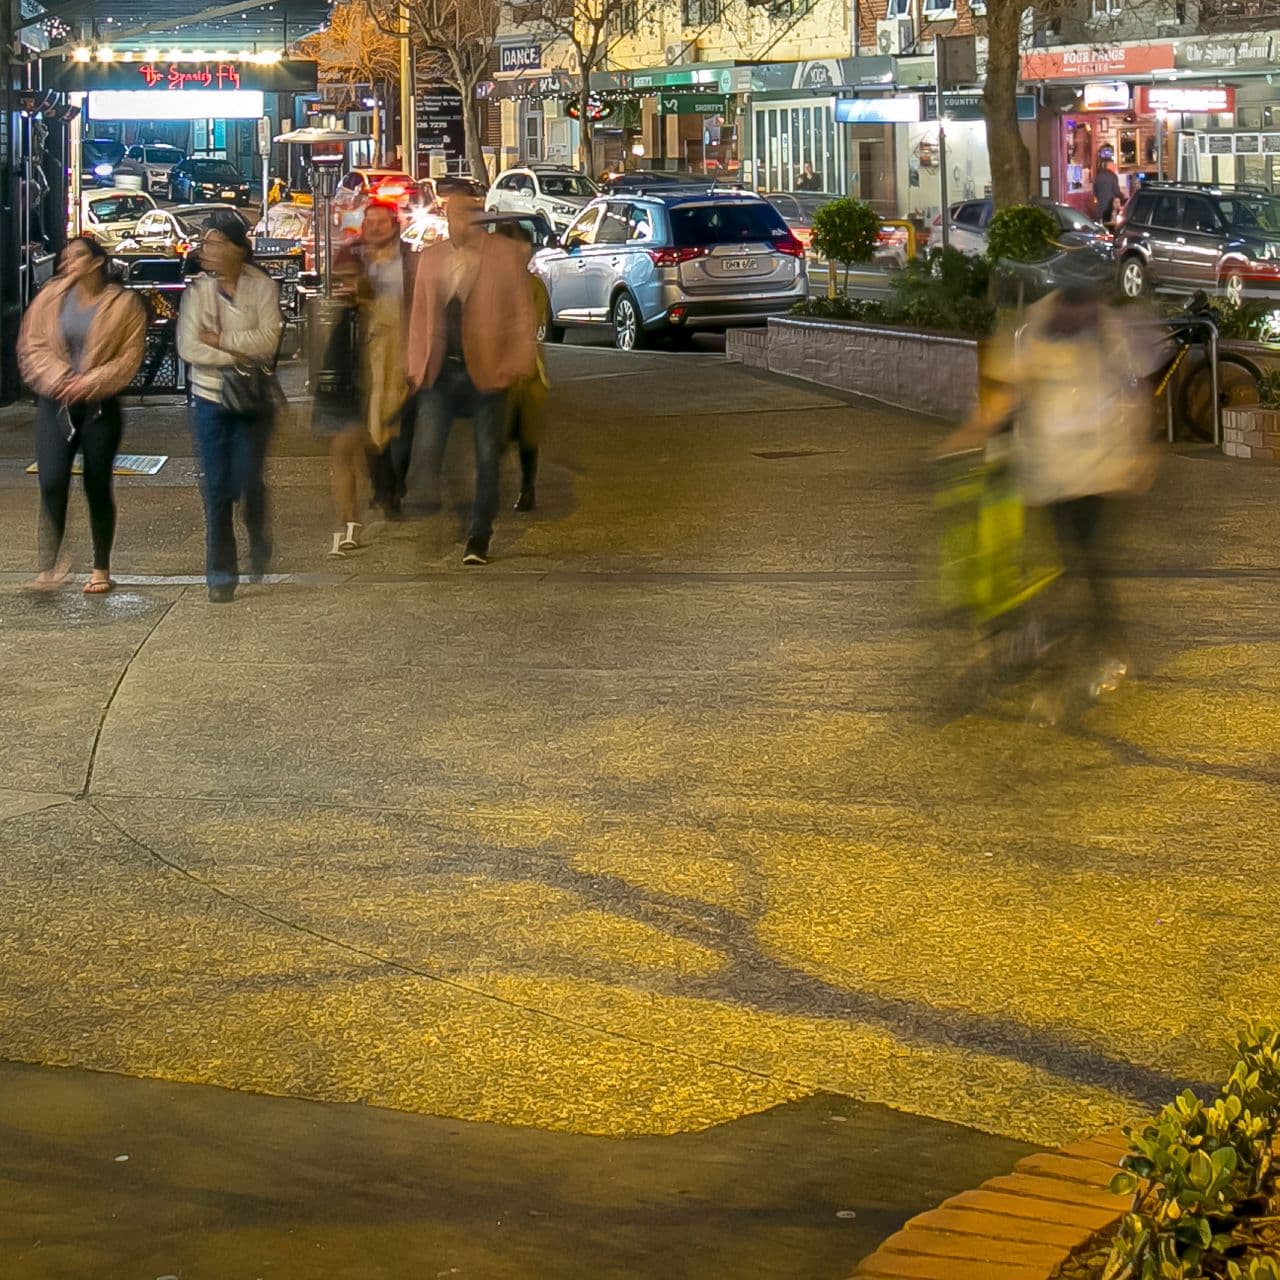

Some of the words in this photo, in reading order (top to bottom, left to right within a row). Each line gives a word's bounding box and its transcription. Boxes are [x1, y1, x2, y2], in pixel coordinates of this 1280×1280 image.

[504, 46, 540, 66] DANCE
[167, 64, 212, 89] Spanish
[216, 64, 240, 89] Fly
